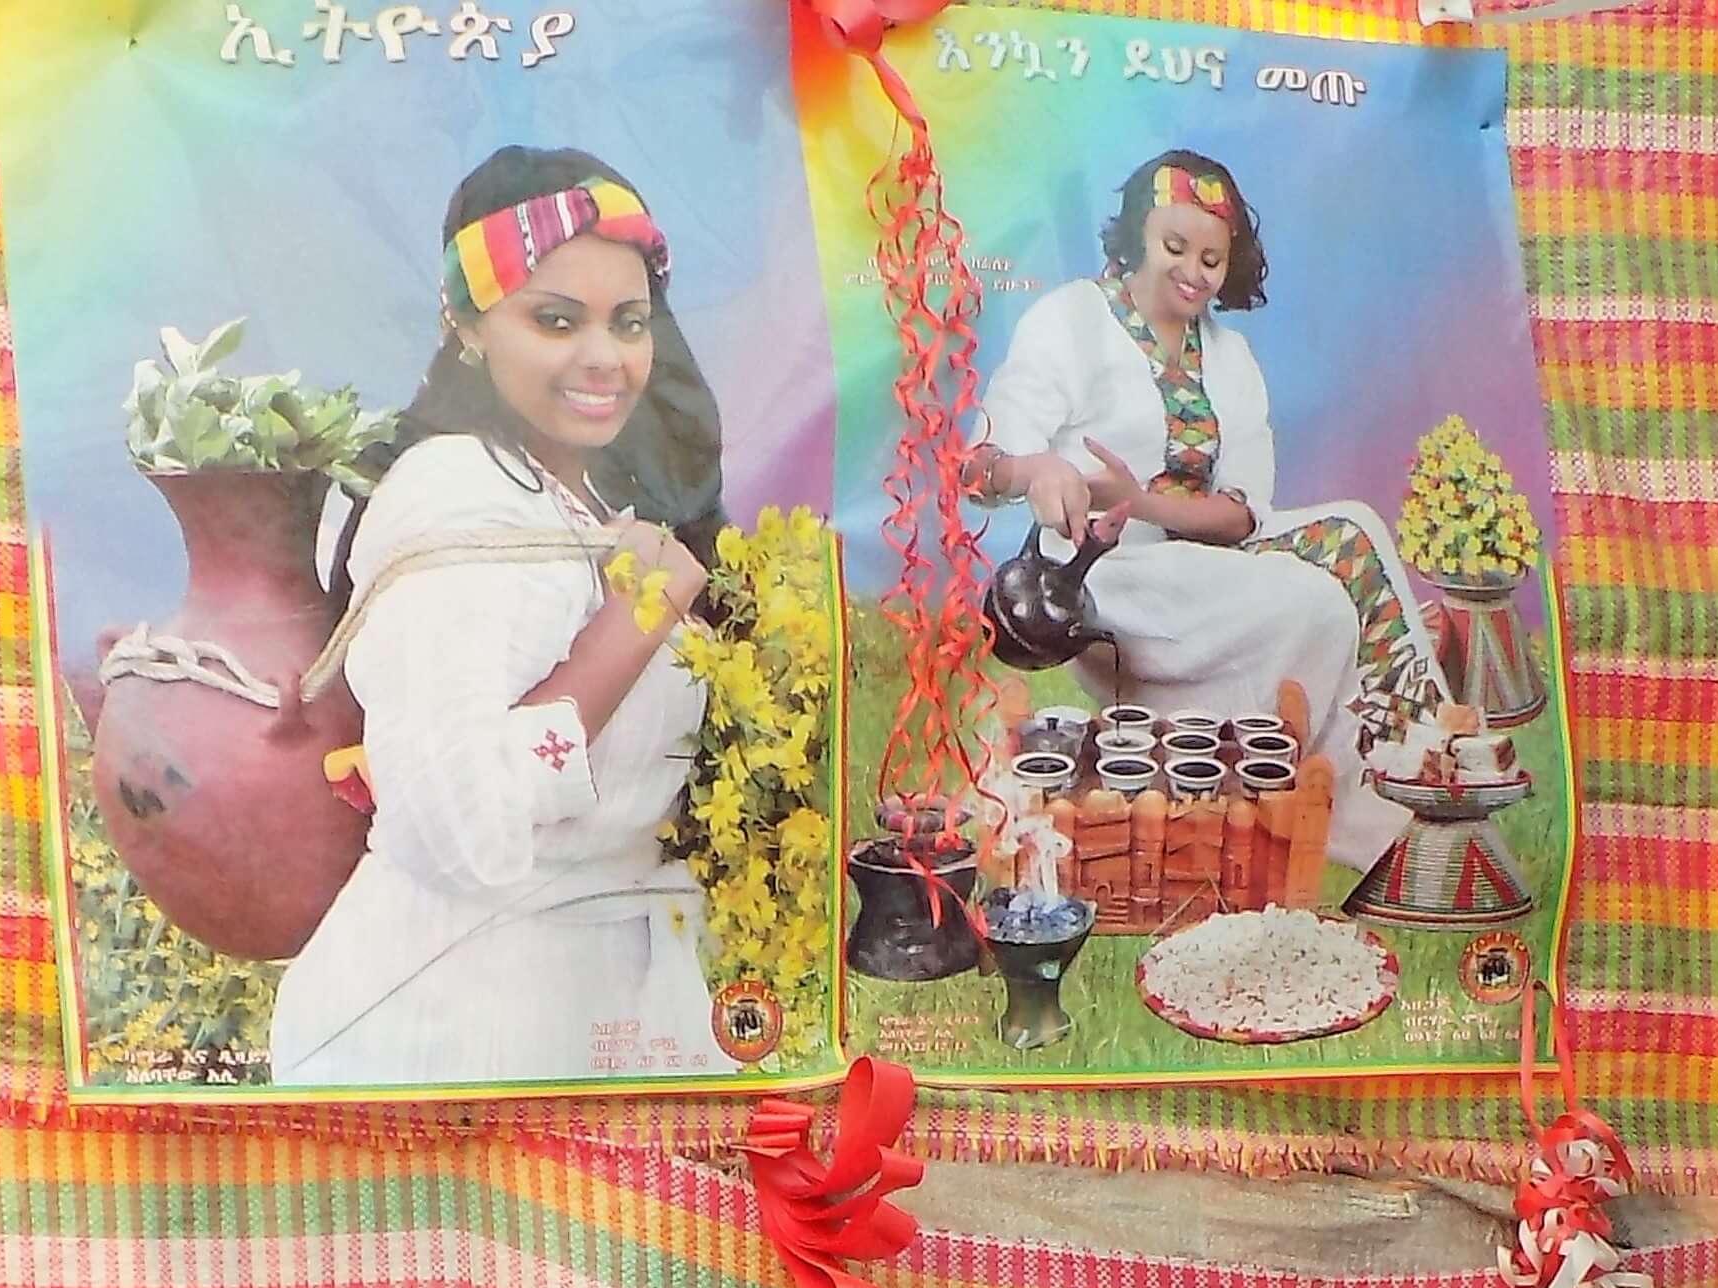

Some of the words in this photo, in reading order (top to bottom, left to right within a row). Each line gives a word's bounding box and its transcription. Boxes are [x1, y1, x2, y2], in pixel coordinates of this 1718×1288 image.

[220, 0, 575, 67] ኢትዮጵያ
[1122, 39, 1226, 89] ደህና
[1254, 67, 1367, 106] መጡ
